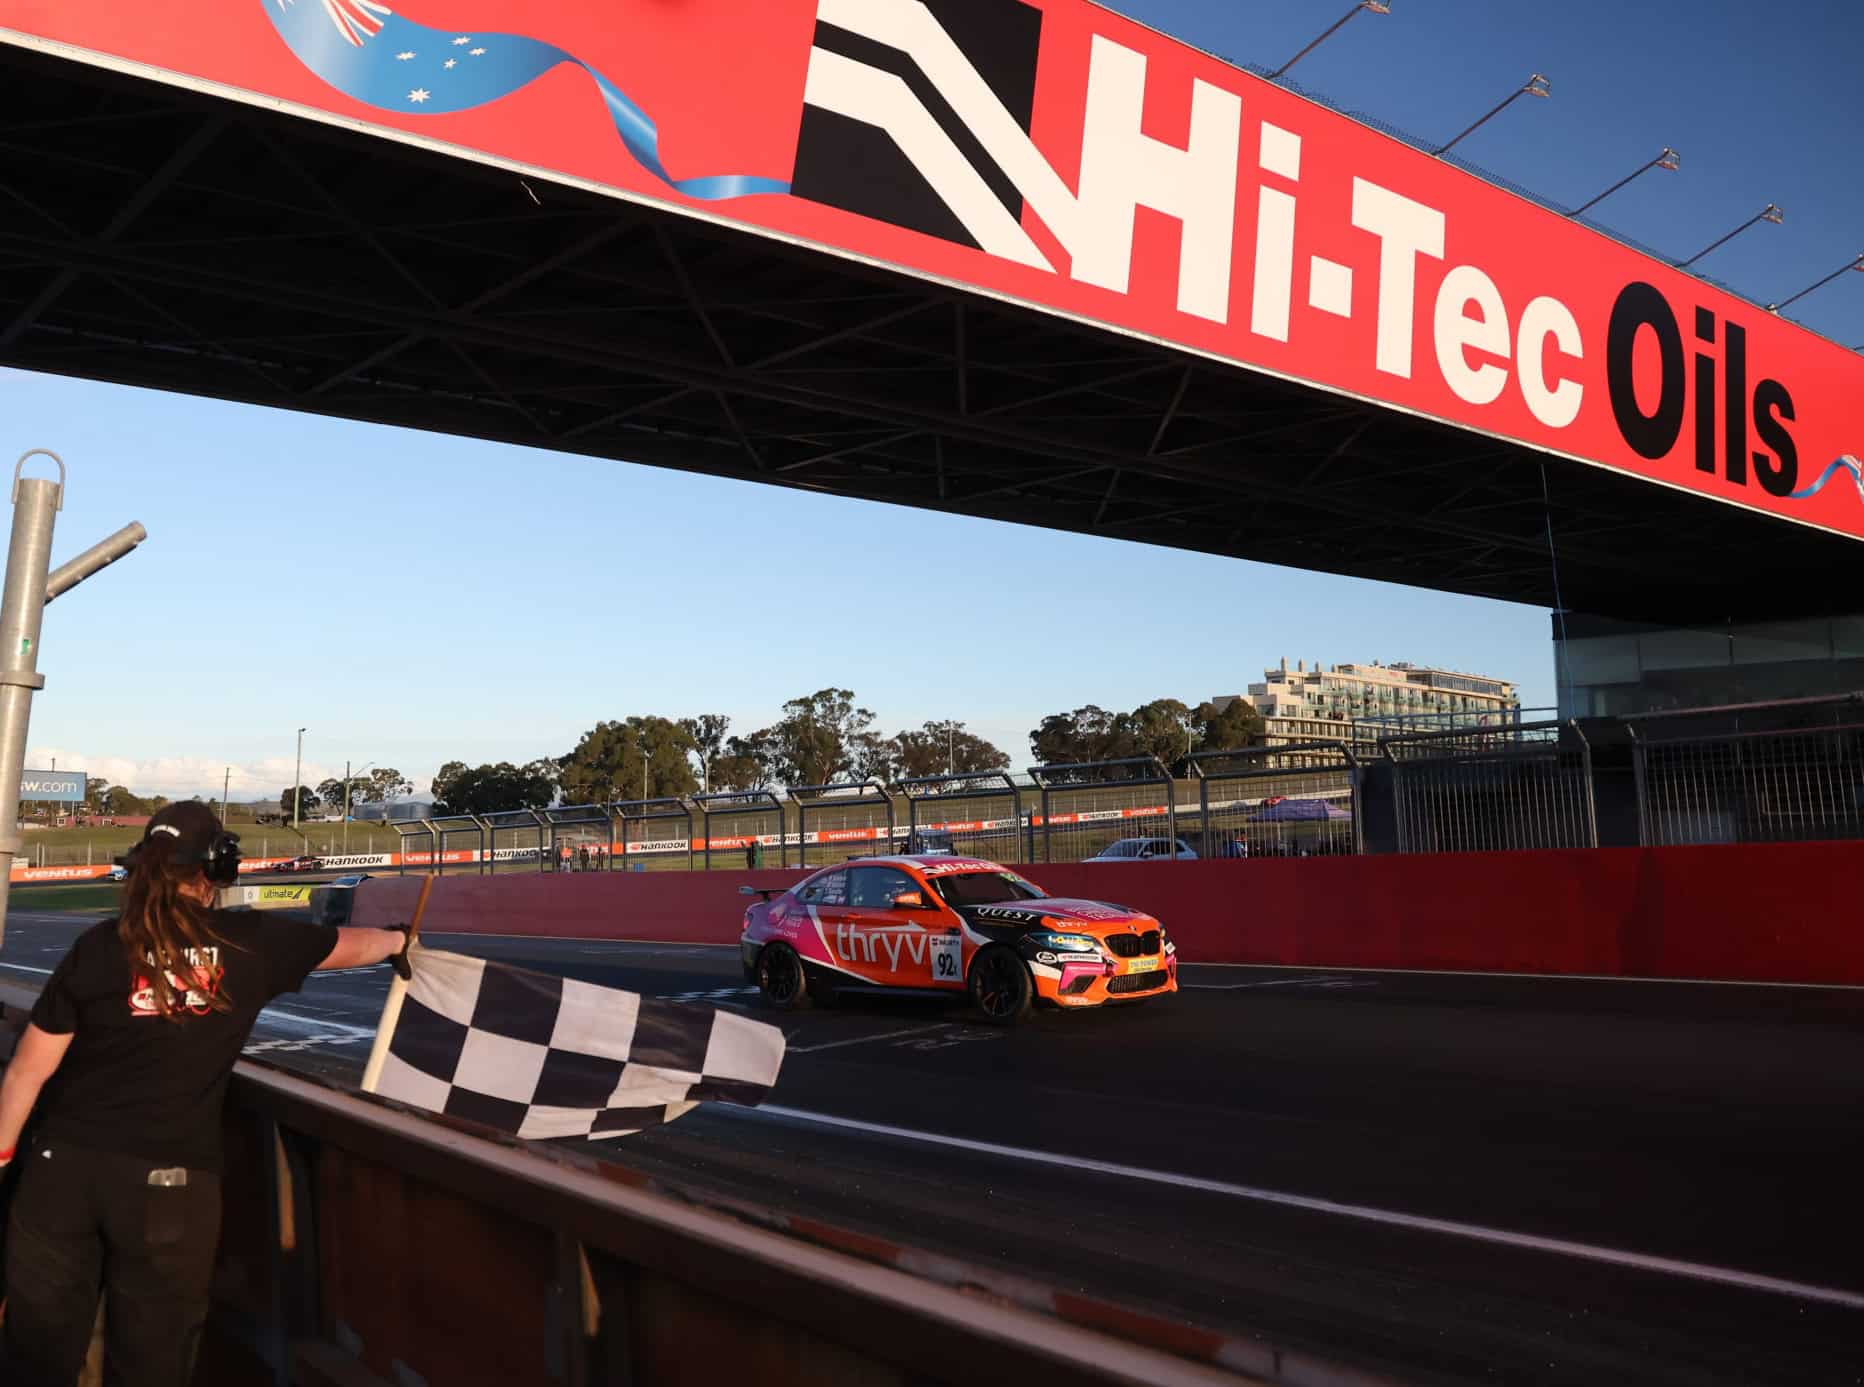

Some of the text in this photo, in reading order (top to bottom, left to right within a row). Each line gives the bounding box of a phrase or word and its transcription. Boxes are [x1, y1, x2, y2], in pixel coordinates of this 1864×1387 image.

[1070, 33, 1799, 498] Hi-Tec Oils
[977, 907, 1036, 921] QUEST
[836, 922, 927, 973] thryv
